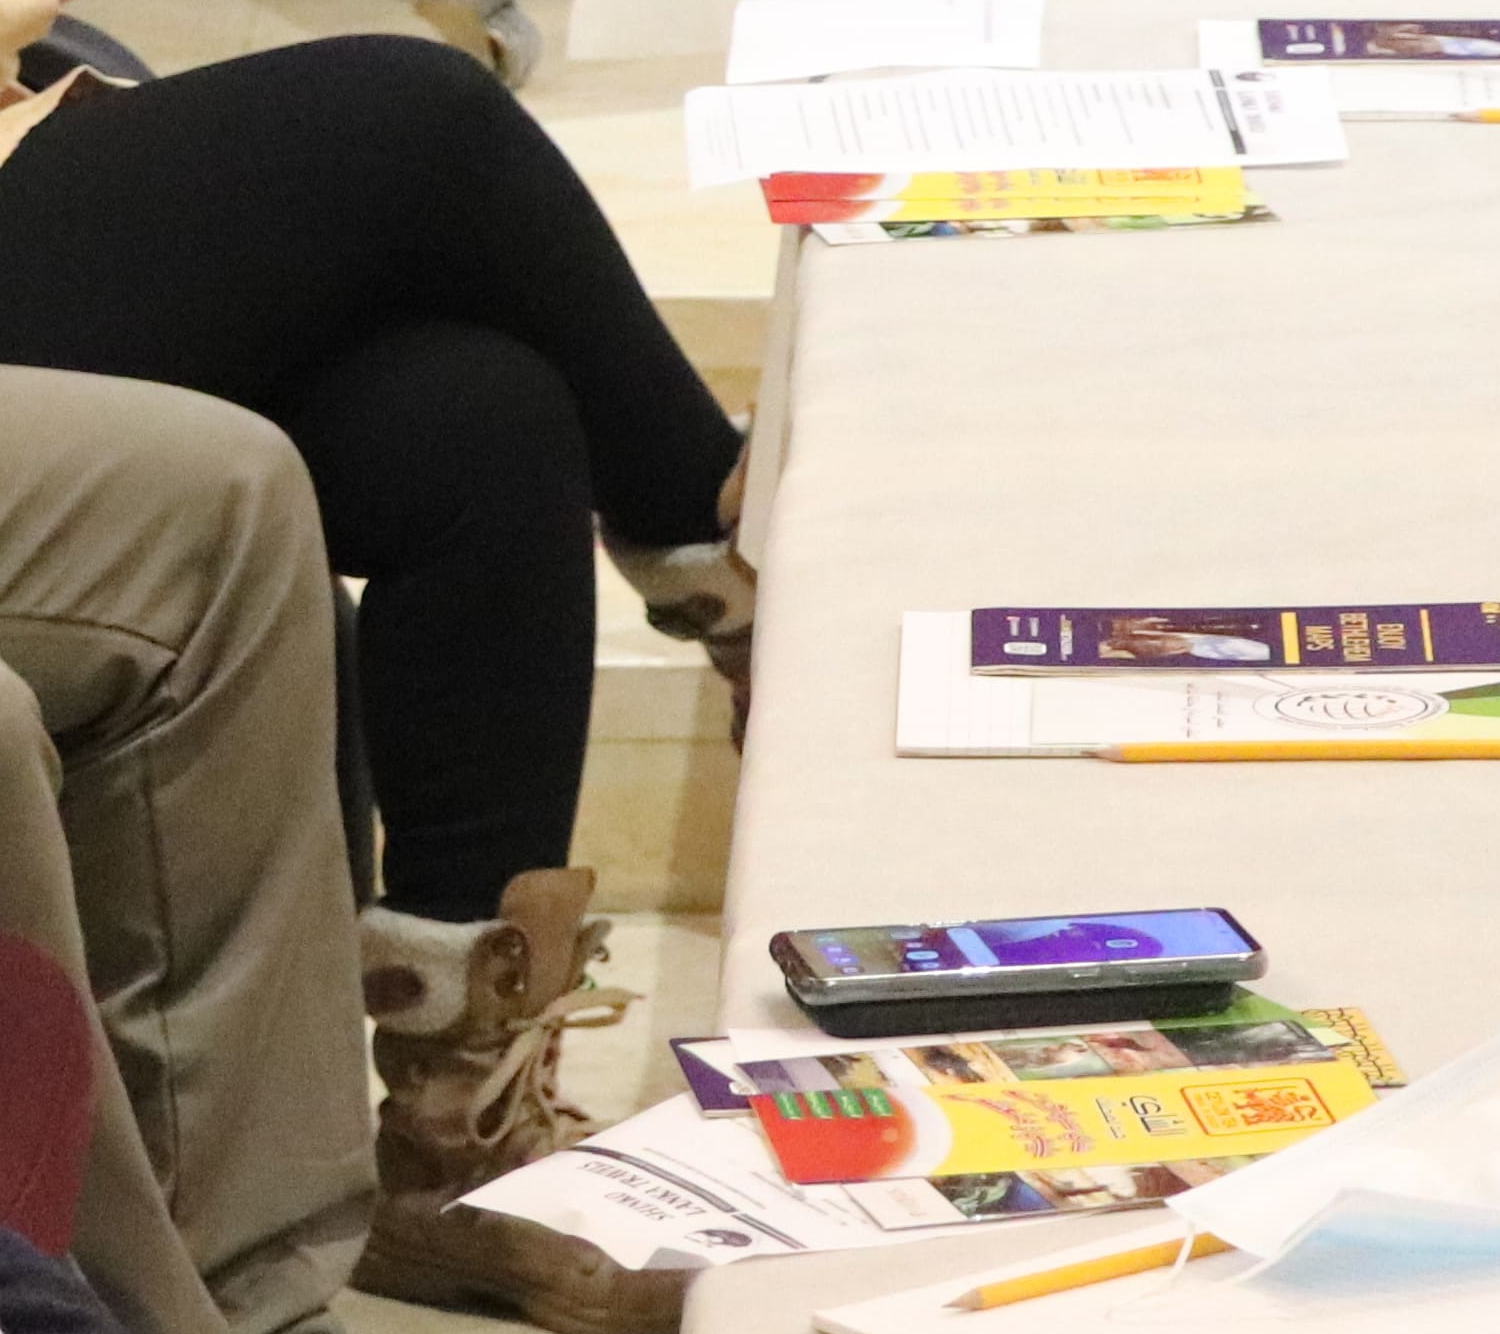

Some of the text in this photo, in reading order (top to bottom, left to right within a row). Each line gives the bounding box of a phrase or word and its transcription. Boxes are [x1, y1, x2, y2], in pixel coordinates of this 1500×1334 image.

[1304, 625, 1335, 651] MAPS
[1338, 612, 1373, 663] BETHLEHEM
[1376, 623, 1406, 650] ENJOY
